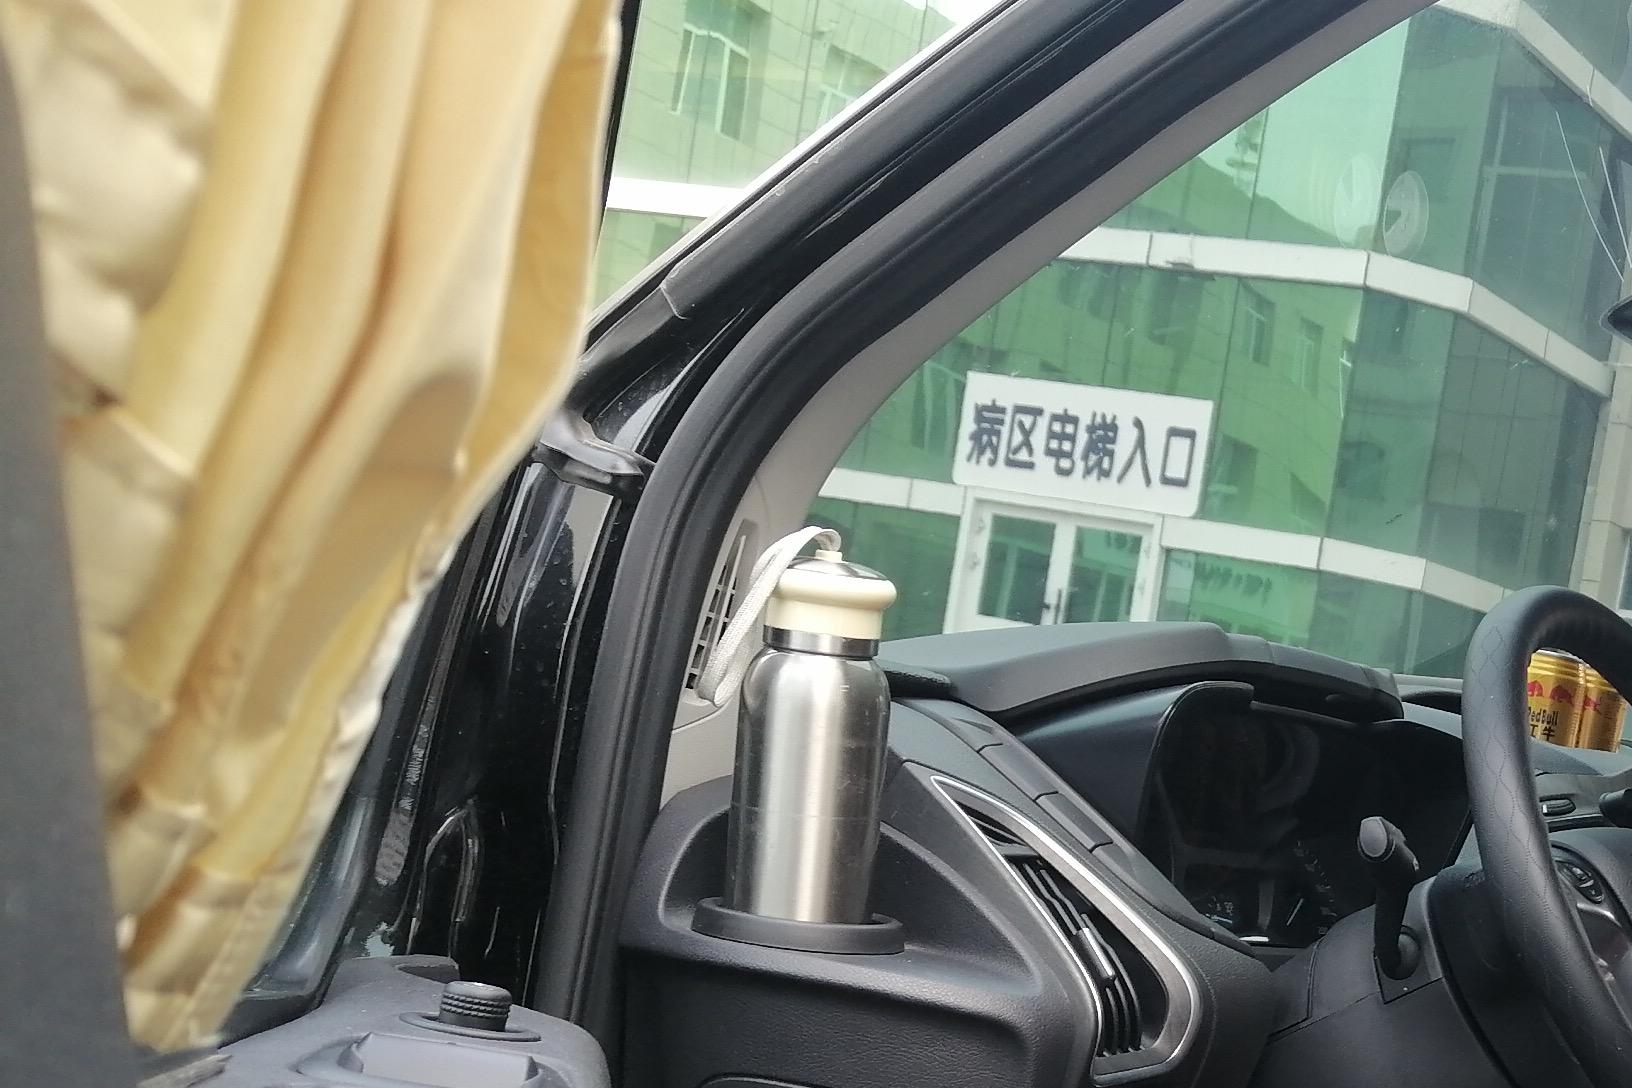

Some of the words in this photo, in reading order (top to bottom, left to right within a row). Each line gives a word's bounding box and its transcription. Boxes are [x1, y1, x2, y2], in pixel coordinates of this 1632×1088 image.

[966, 399, 1197, 487] 病区电梯入口
